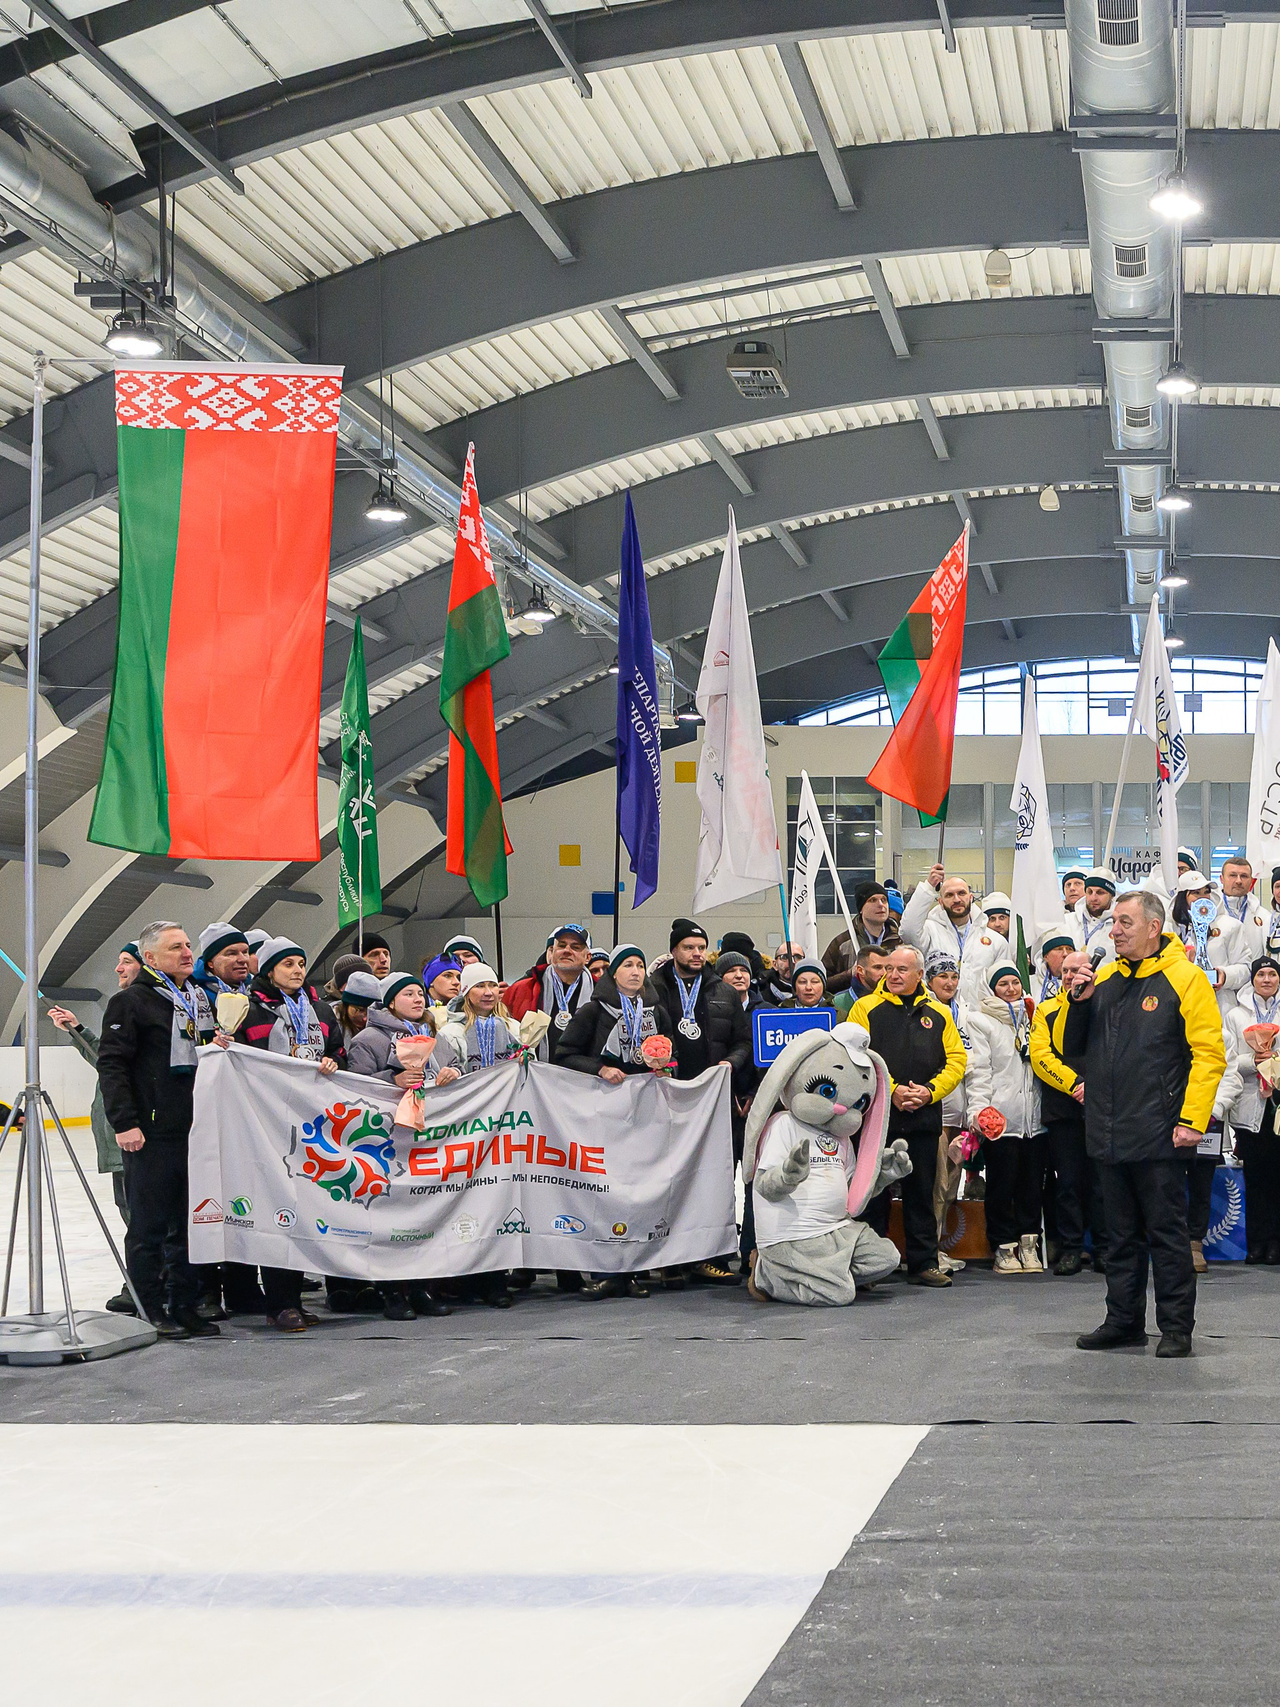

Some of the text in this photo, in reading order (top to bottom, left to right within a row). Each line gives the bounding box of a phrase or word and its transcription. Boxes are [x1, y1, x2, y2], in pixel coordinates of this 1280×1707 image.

[1039, 1060, 1064, 1084] BELARUS
[414, 1110, 534, 1142] КОМАНДА
[408, 1134, 607, 1182] ЕДИНЫЕ
[410, 1184, 442, 1195] КОГДА
[445, 1182, 464, 1193] МЫ
[512, 1173, 528, 1182] МЫ
[530, 1174, 610, 1193] НЕПОБЕДИМЫ!
